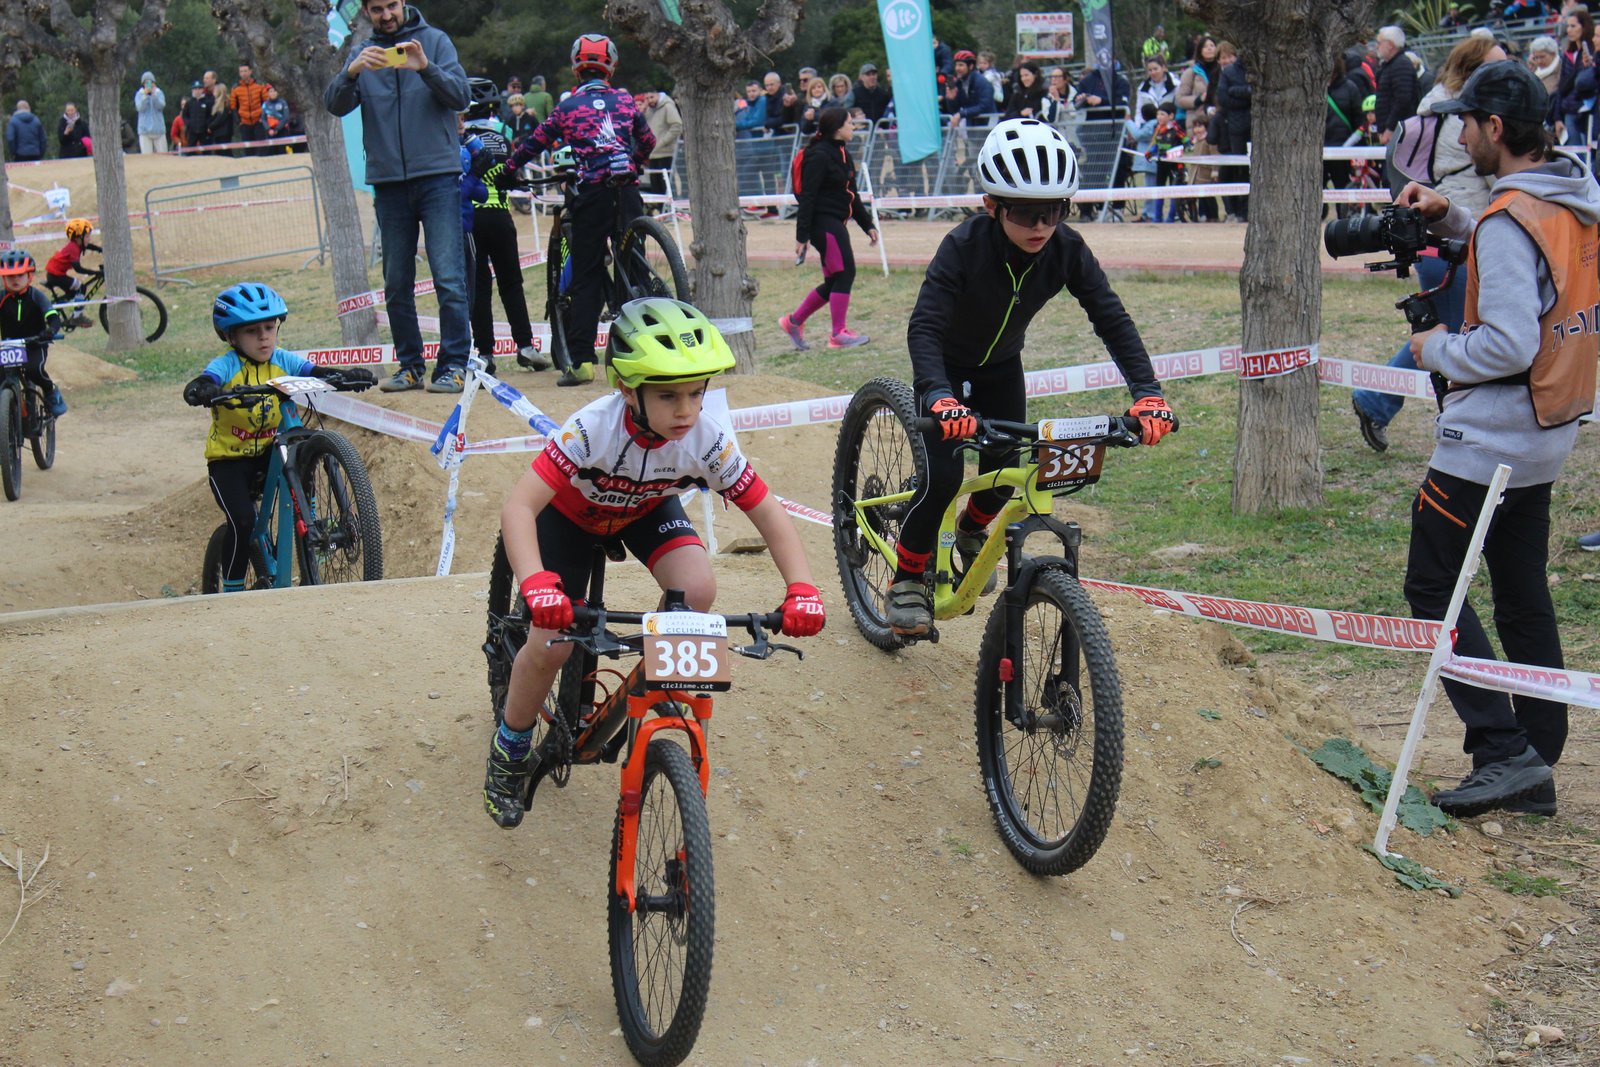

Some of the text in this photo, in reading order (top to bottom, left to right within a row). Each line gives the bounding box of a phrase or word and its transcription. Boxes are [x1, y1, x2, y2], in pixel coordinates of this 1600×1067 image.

[1, 349, 23, 364] 802
[308, 352, 382, 366] BAUHAUS
[284, 381, 324, 392] 386
[941, 409, 968, 419] FOX
[1152, 410, 1174, 422] FOX
[1058, 431, 1091, 439] CICLISME
[1045, 444, 1096, 478] 393
[532, 594, 565, 608] FOX
[796, 602, 824, 616] FOX
[655, 640, 718, 678] 385
[660, 682, 715, 690] ciclisme.cat
[986, 776, 1035, 857] SCHWALBE
